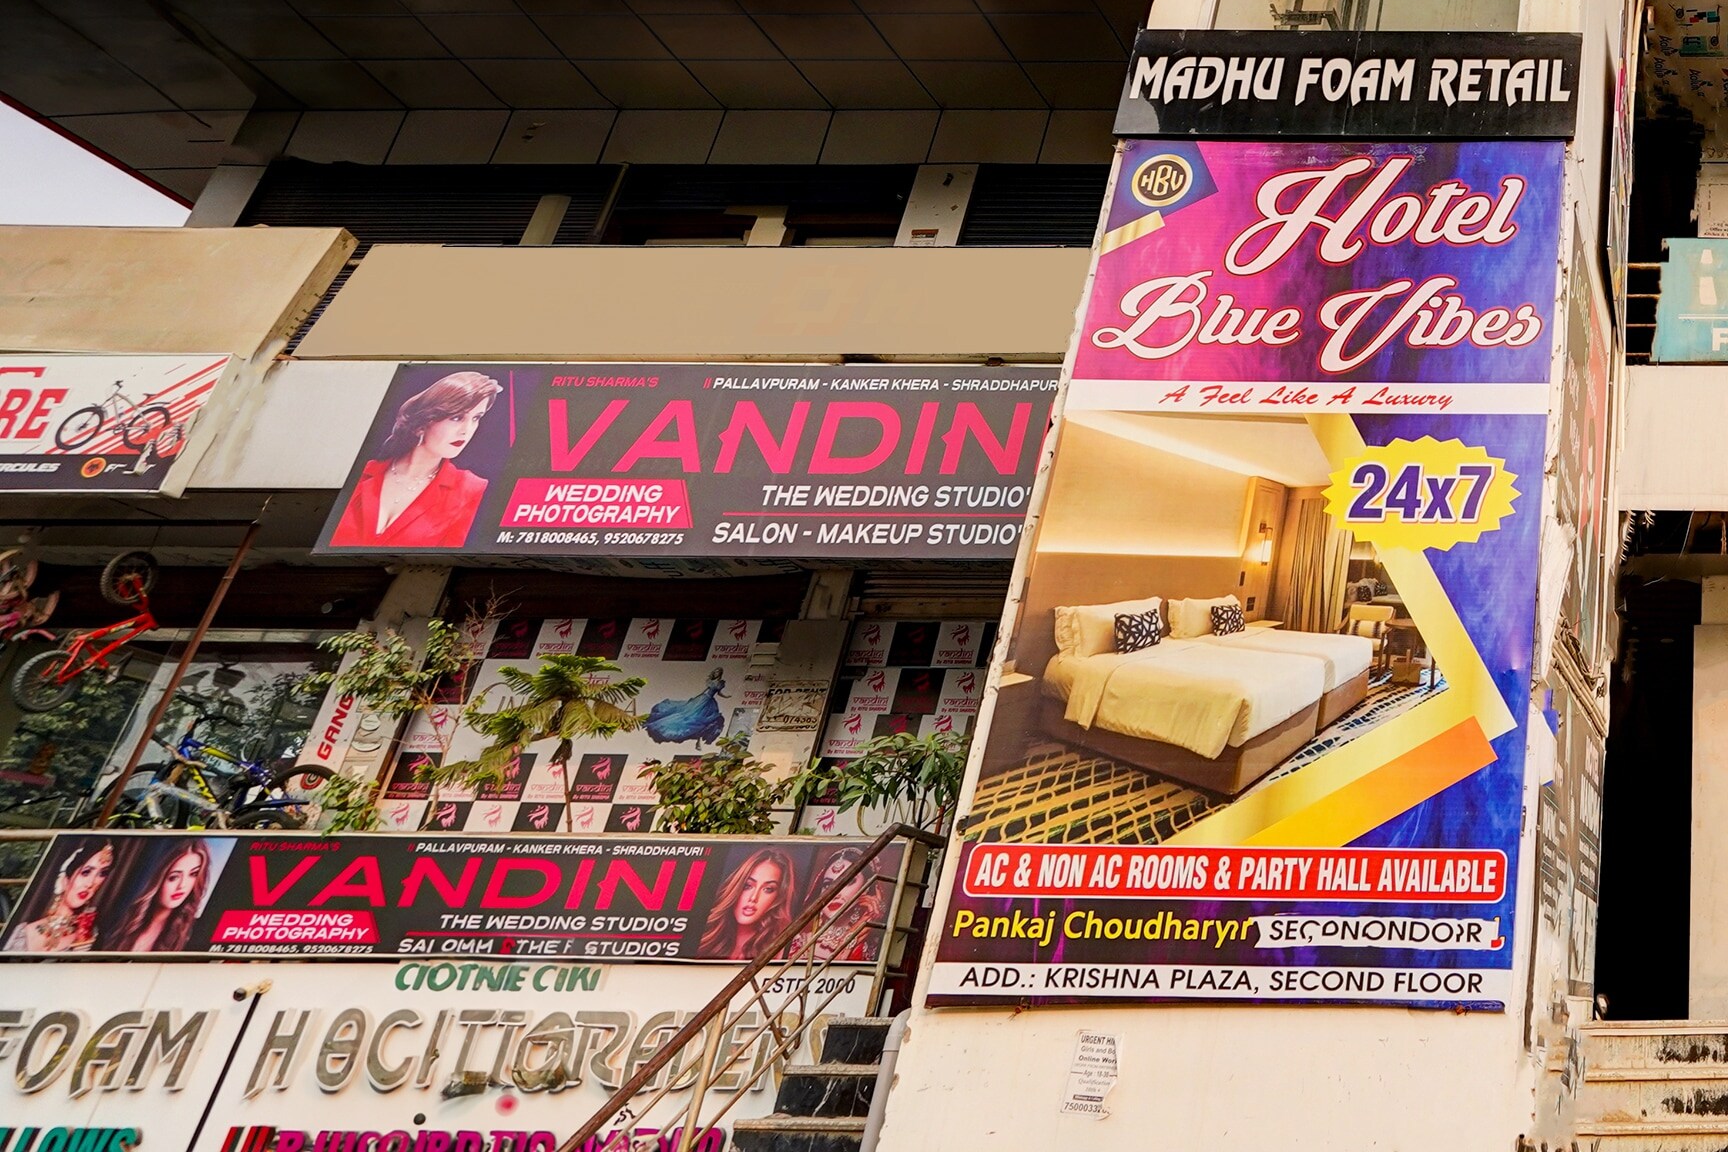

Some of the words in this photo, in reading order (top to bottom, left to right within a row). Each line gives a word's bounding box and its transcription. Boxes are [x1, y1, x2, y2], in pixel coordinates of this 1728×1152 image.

[1128, 56, 1285, 105] MADHU
[1295, 58, 1416, 106] FOAM
[1428, 58, 1571, 106] RETAIL
[1225, 156, 1527, 276] Hotel
[1095, 271, 1302, 360] Blue
[1318, 277, 1543, 373] Vibes
[551, 376, 585, 387] RITU
[586, 376, 659, 388] SHARMA'S
[713, 378, 821, 390] PALLAVPURAM
[829, 379, 889, 390] KANKER
[890, 379, 940, 391] KHERA
[1158, 385, 1187, 405] A
[1199, 386, 1252, 406] Feel
[1259, 386, 1319, 406] Like
[1327, 388, 1355, 407] A
[1363, 387, 1453, 411] Luxury
[548, 399, 1052, 475] VANDIN
[544, 484, 663, 502] WEDDING
[761, 485, 807, 507] THE
[816, 485, 929, 508] WEDDING
[1346, 463, 1496, 523] 24x7
[513, 504, 681, 525] PHOTOGRAPHY
[497, 532, 513, 544] M:
[604, 533, 684, 545] 9520678275
[712, 522, 796, 544] SALON
[816, 523, 924, 545] MAKEUP
[248, 855, 706, 911] VANDINI
[973, 852, 1007, 888] AC
[1013, 853, 1032, 887] &
[1038, 853, 1085, 889] NON
[1090, 854, 1121, 889] AC
[1127, 854, 1209, 890] ROOMS
[1213, 855, 1232, 891] &
[1237, 856, 1312, 892] PARTY
[1315, 857, 1372, 893] HALL
[1376, 857, 1498, 895] AVAILABLE
[952, 909, 1056, 947] Pankaj
[1044, 966, 1161, 990] KRISHNA
[1169, 968, 1260, 994] PLAZA,
[1268, 970, 1385, 994] SECOND
[1393, 971, 1484, 995] FLOOR
[1080, 1034, 1106, 1046] URGENT
[1078, 1054, 1101, 1064] Online
[1083, 1070, 1093, 1078] Age
